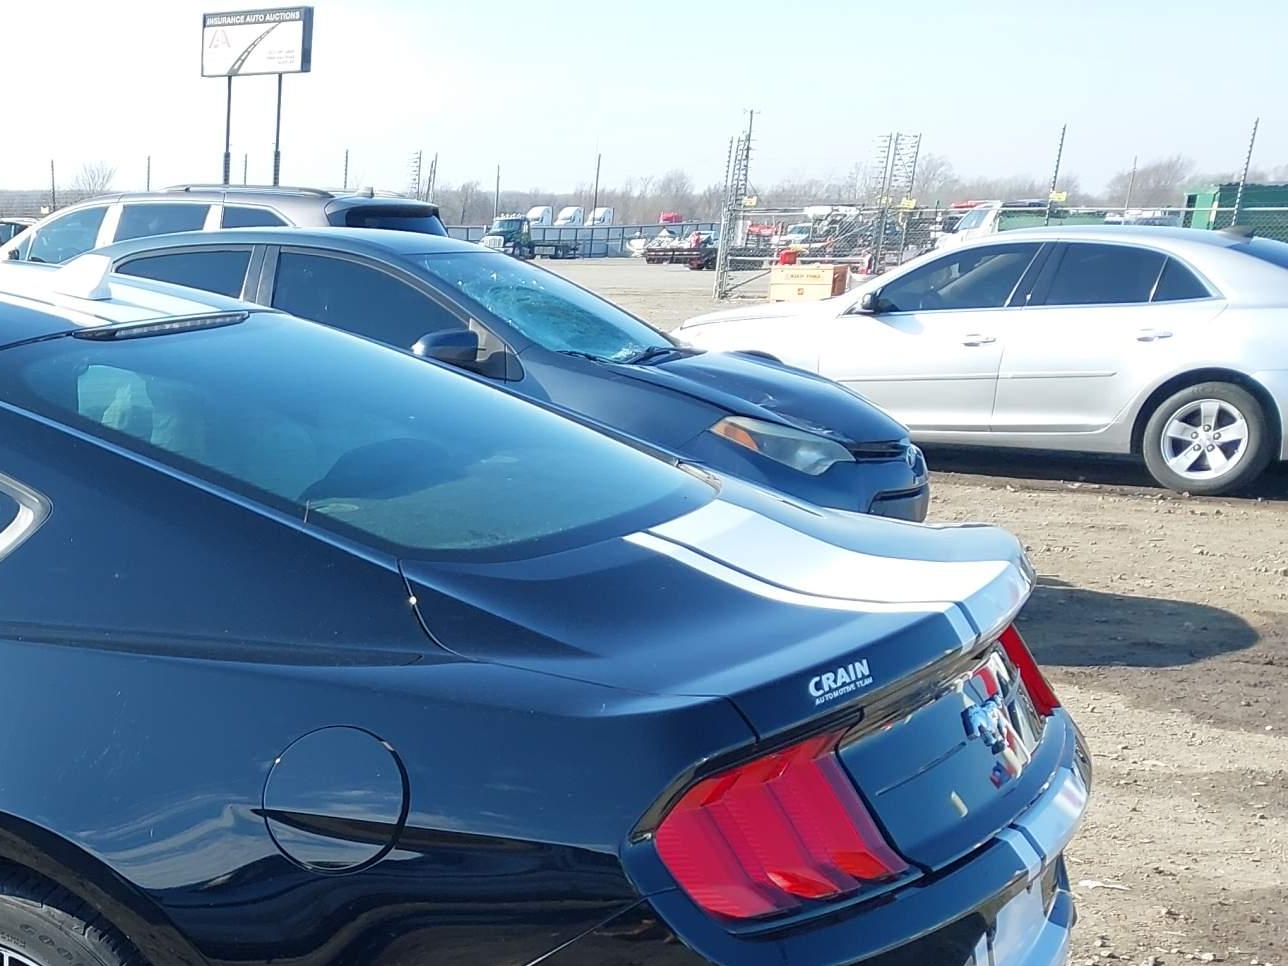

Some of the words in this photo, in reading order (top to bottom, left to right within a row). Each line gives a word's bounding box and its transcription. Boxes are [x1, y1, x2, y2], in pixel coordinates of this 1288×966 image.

[206, 15, 245, 25] INSURANCE
[245, 13, 265, 23] AUTO
[265, 10, 300, 21] AUCTIONS
[808, 658, 870, 697] CRAIN
[815, 683, 856, 705] AUTOMOTIVE
[855, 676, 873, 688] TEAM
